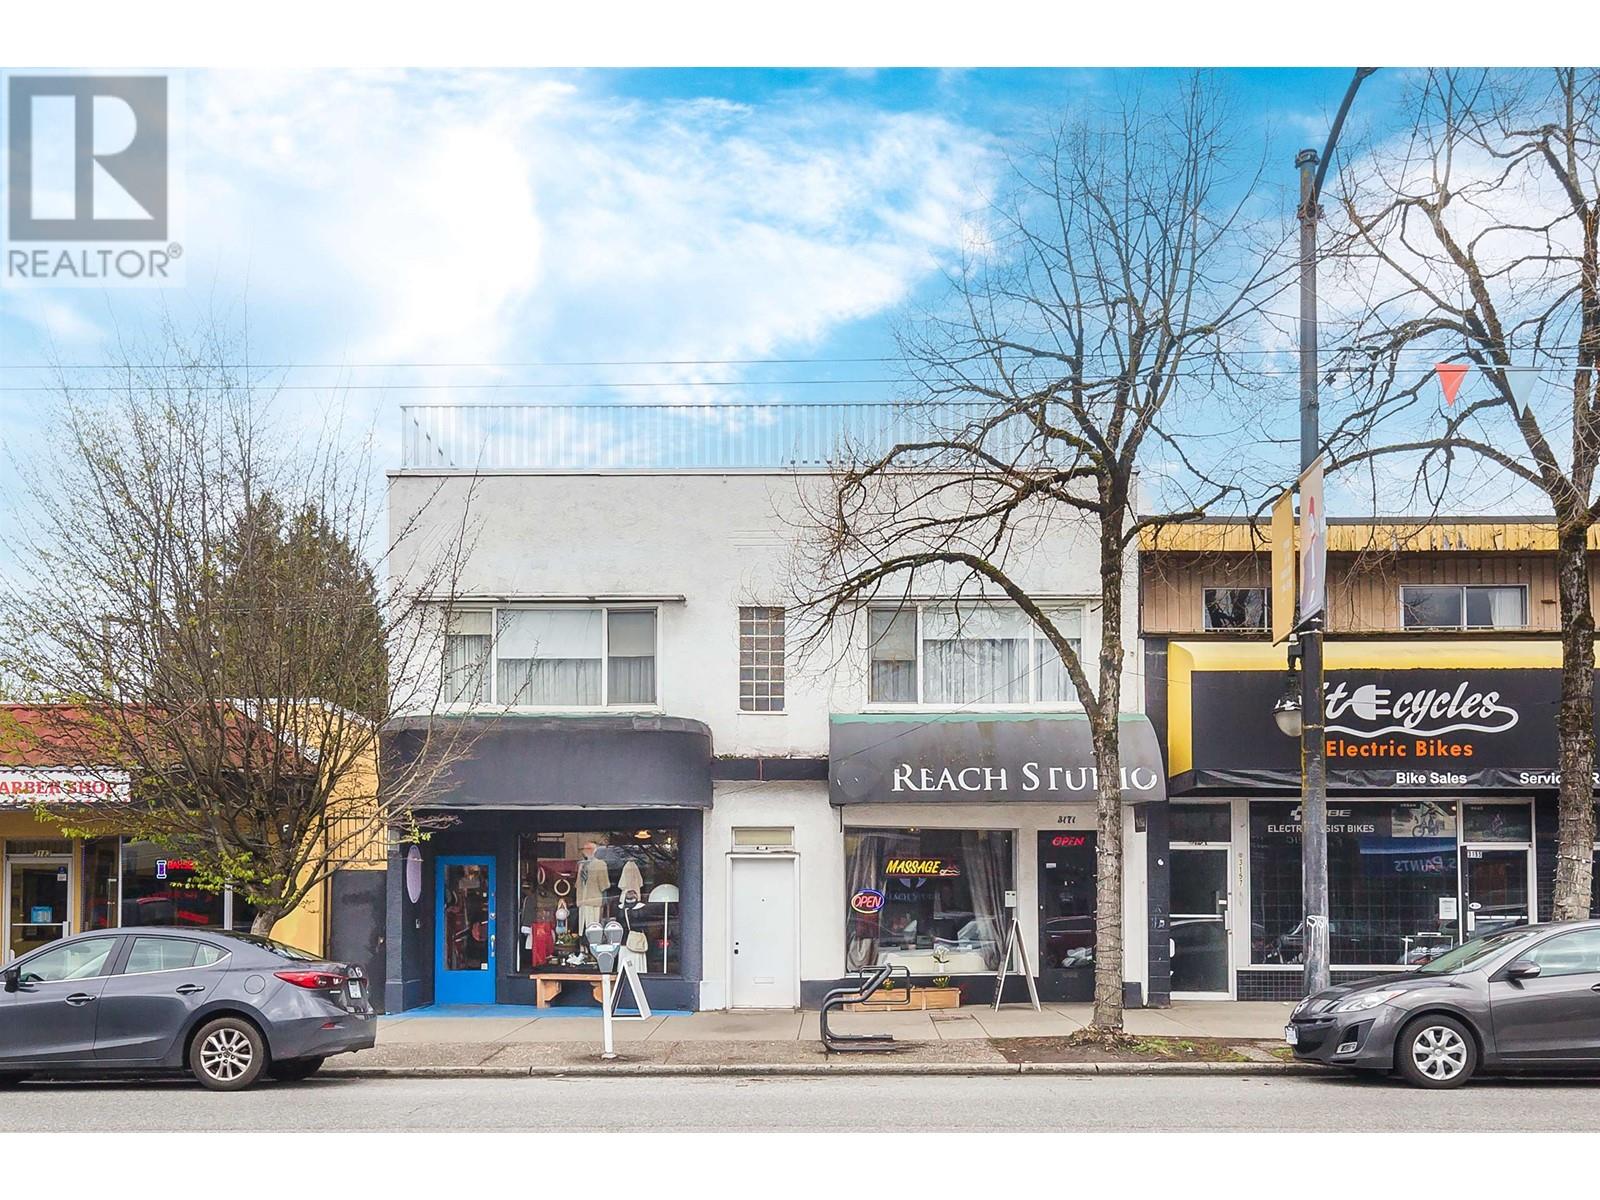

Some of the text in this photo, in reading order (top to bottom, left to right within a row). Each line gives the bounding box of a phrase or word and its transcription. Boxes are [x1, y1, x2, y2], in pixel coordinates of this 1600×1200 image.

[1326, 740, 1473, 757] Electric Bikes
[891, 762, 1158, 792] REACH STUIO
[1396, 772, 1561, 784] Bike Sales Servic
[0, 781, 61, 794] ARBER
[1267, 824, 1375, 833] ELECTR SIST BIKES
[1051, 836, 1085, 847] OPEN
[885, 860, 941, 874] MASSAGE
[853, 895, 881, 908] OPEN
